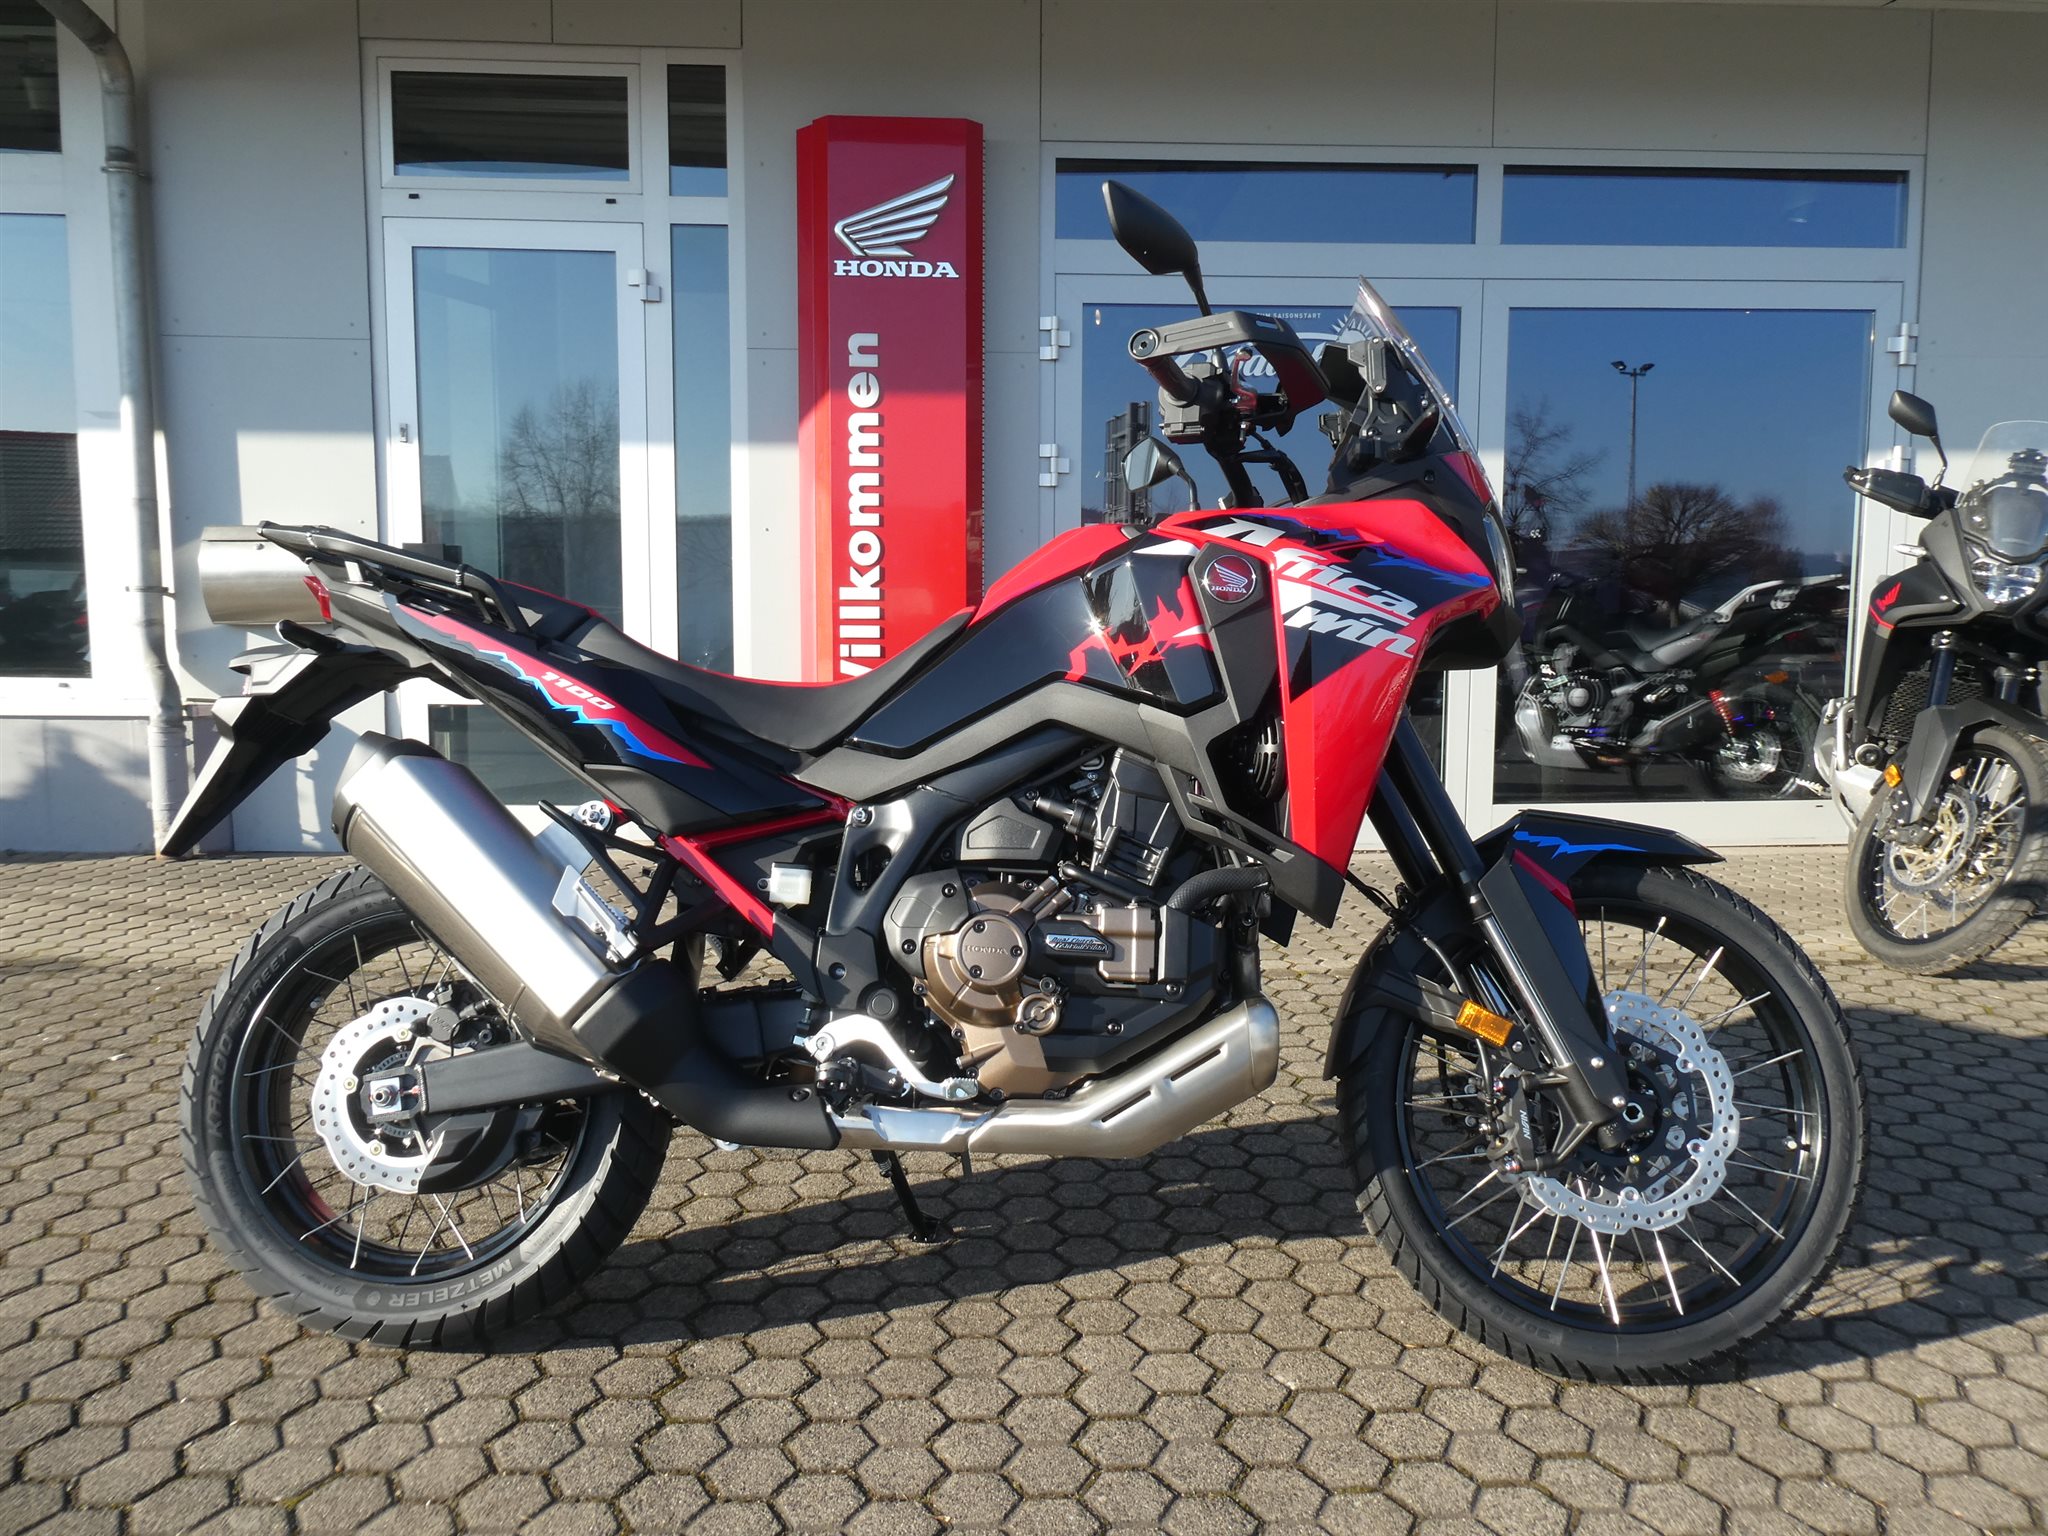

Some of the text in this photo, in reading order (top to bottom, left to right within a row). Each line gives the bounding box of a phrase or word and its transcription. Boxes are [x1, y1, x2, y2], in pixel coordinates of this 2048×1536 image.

[833, 259, 960, 278] HONDA
[1210, 585, 1248, 594] HONDA
[540, 671, 616, 710] 1100
[965, 944, 1009, 955] HONDA
[236, 947, 289, 1022] STREET
[388, 1258, 513, 1308] METZELER
